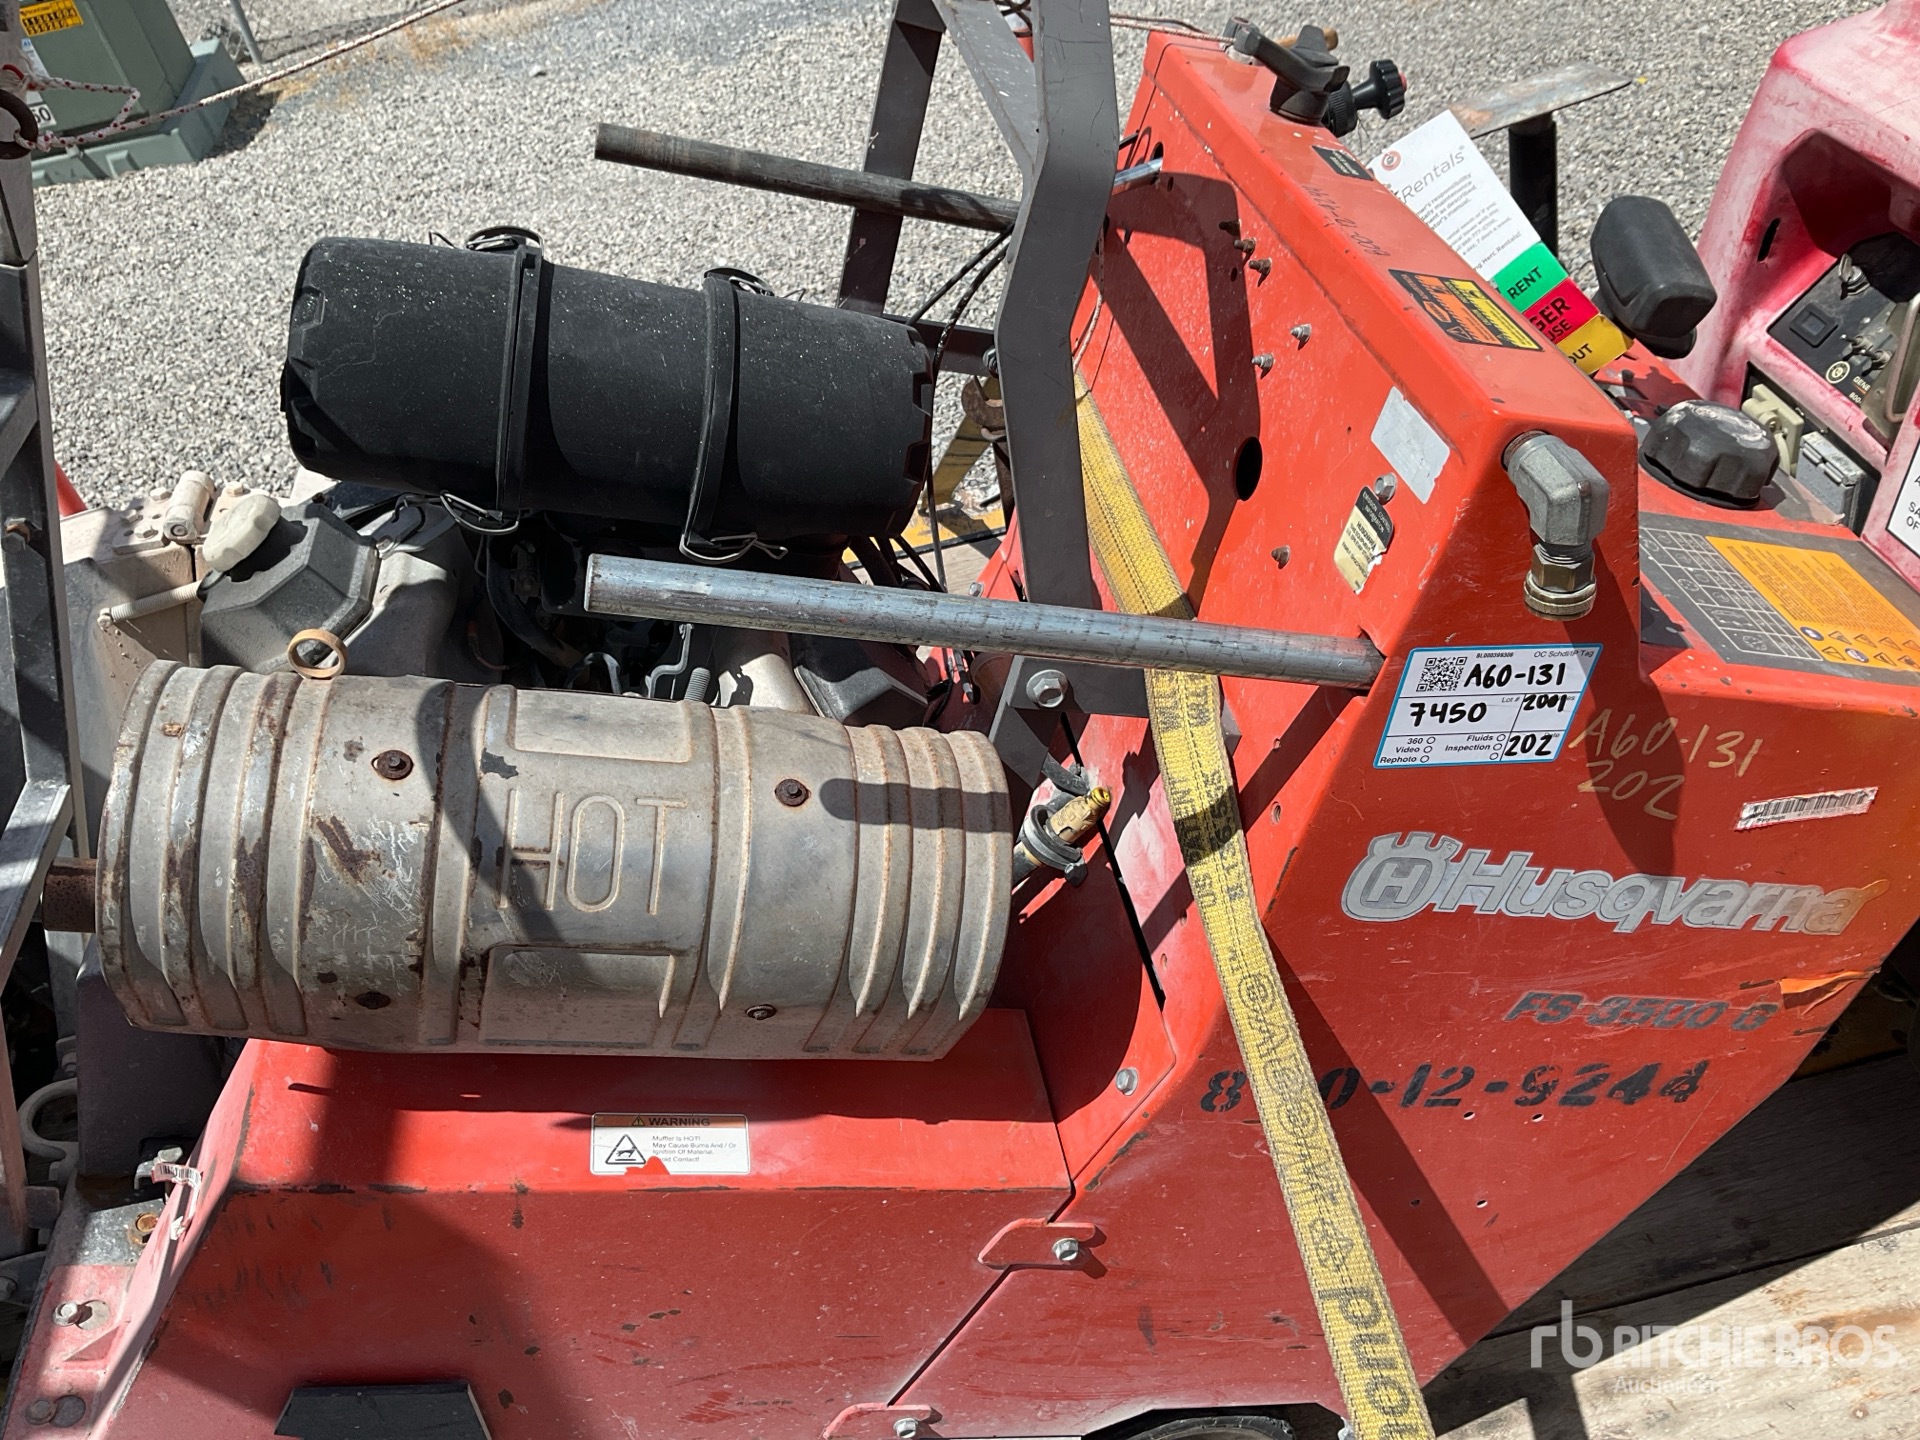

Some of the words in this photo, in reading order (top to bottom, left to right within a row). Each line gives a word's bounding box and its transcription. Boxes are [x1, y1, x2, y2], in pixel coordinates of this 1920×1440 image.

[1507, 266, 1544, 301] RENT
[1464, 663, 1566, 689] A60-131
[1409, 702, 1488, 727] 7450
[1444, 744, 1491, 752] Inspection
[1466, 734, 1494, 742] Fluids
[1504, 733, 1554, 757] 202
[1568, 709, 1763, 777] A60-131
[1380, 756, 1417, 764] Rephoto
[1577, 759, 1685, 820] 202
[496, 788, 688, 915] HOT
[1437, 848, 1886, 936] Husqvarna
[649, 1118, 711, 1126] WARNING
